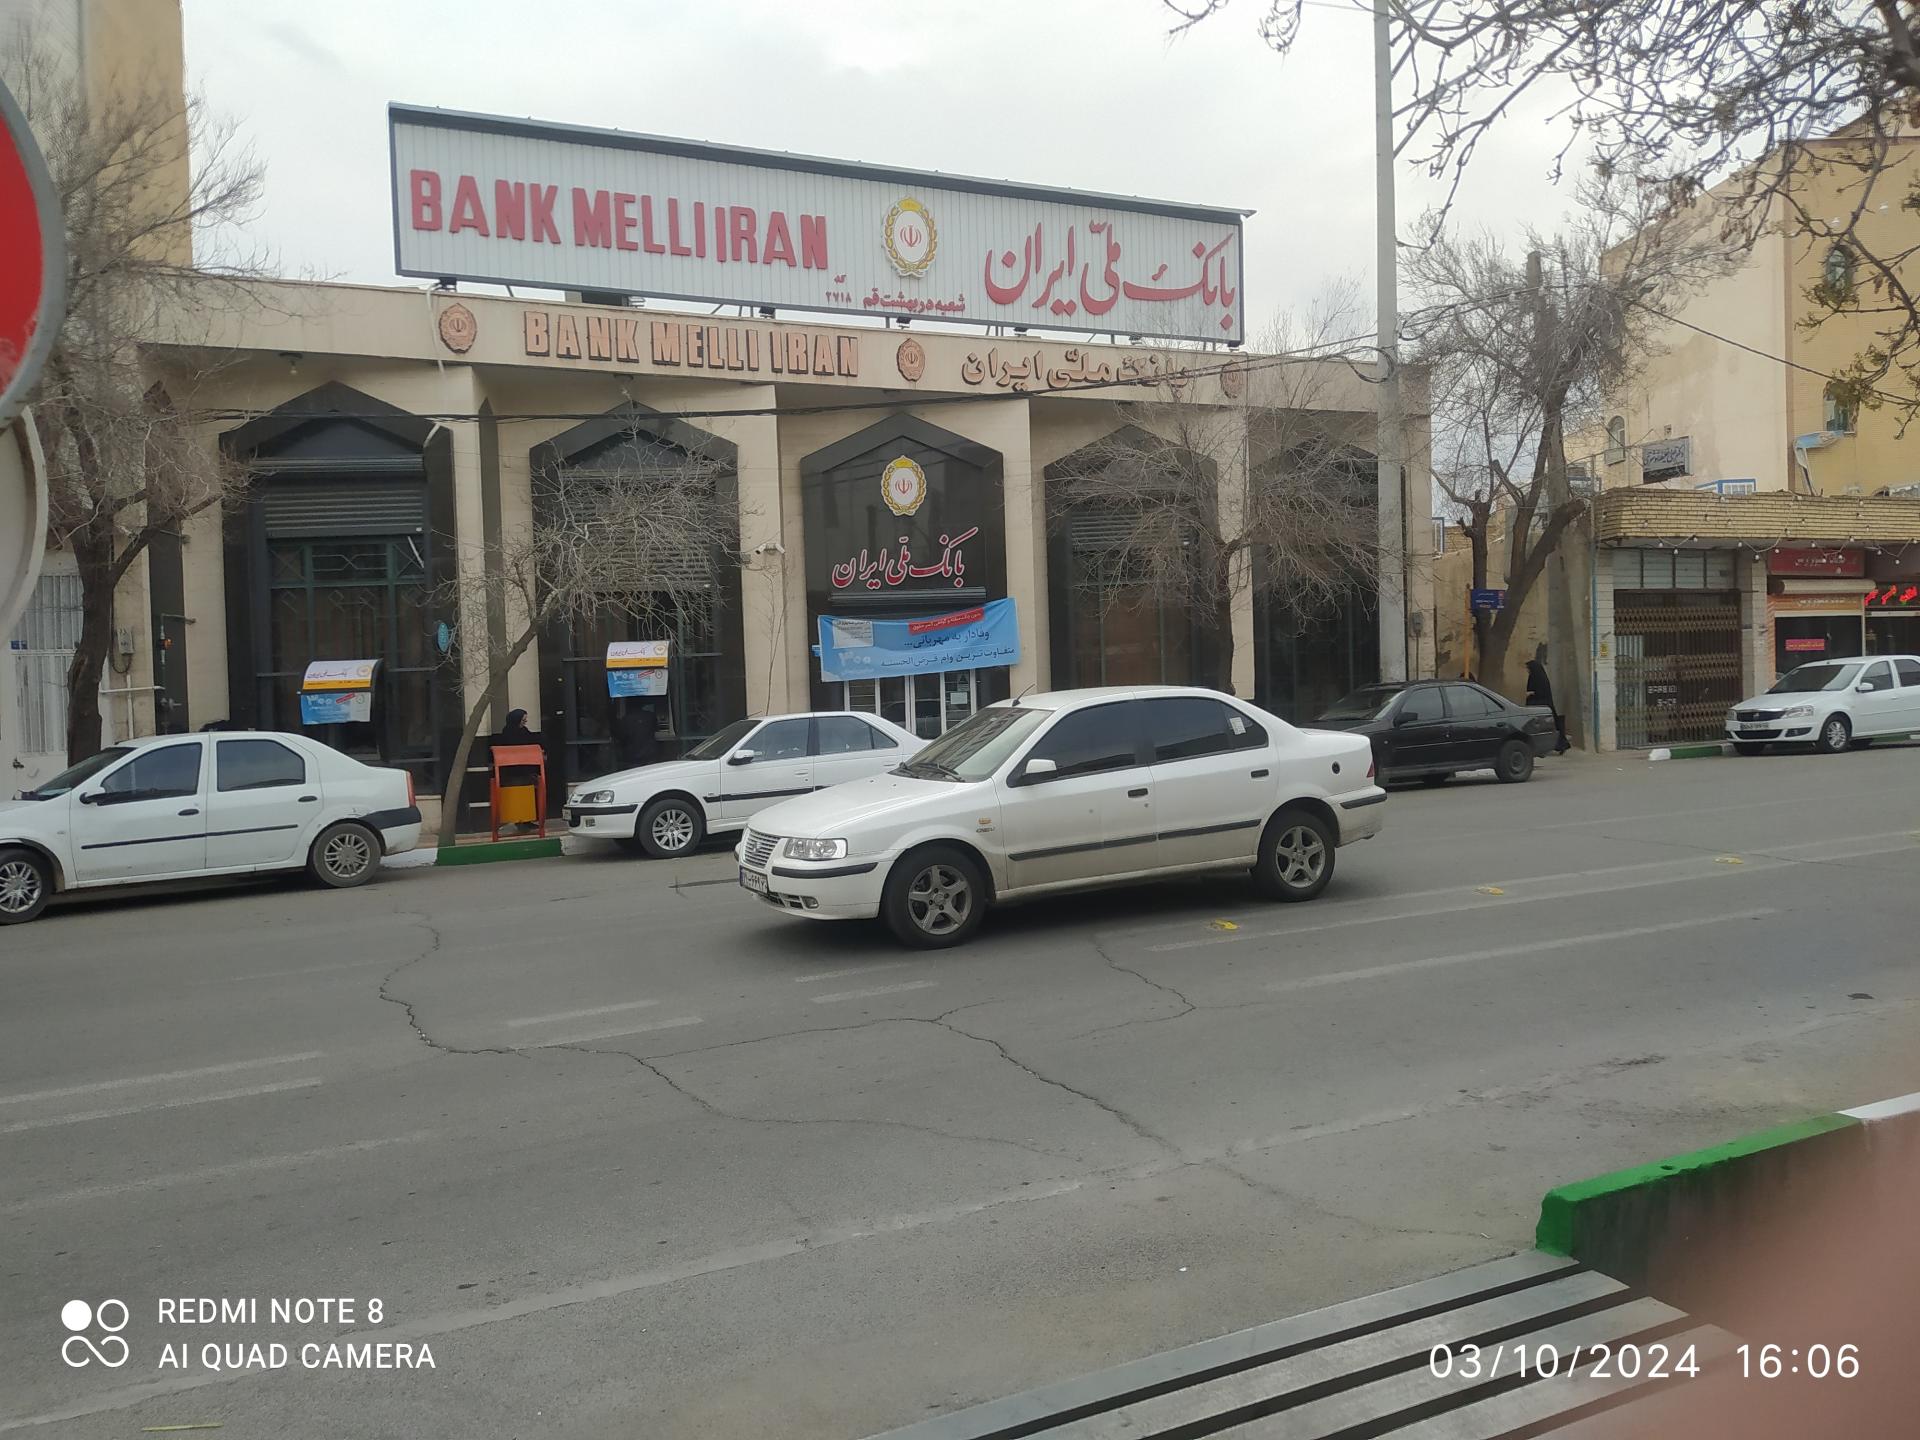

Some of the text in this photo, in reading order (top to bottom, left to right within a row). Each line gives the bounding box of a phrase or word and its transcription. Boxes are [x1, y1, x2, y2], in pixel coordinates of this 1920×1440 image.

[410, 169, 828, 270] BANK MELLI IRAN
[984, 222, 1076, 316] ایران
[863, 287, 880, 308] قم
[935, 293, 966, 316] شعبه
[524, 310, 859, 378] BANK MELLI IRAN
[961, 347, 1043, 392] ایران
[831, 548, 887, 590] ایران
[909, 526, 978, 588] بانک
[951, 632, 961, 641] به
[965, 628, 990, 643] وفادار
[940, 653, 953, 664] وام
